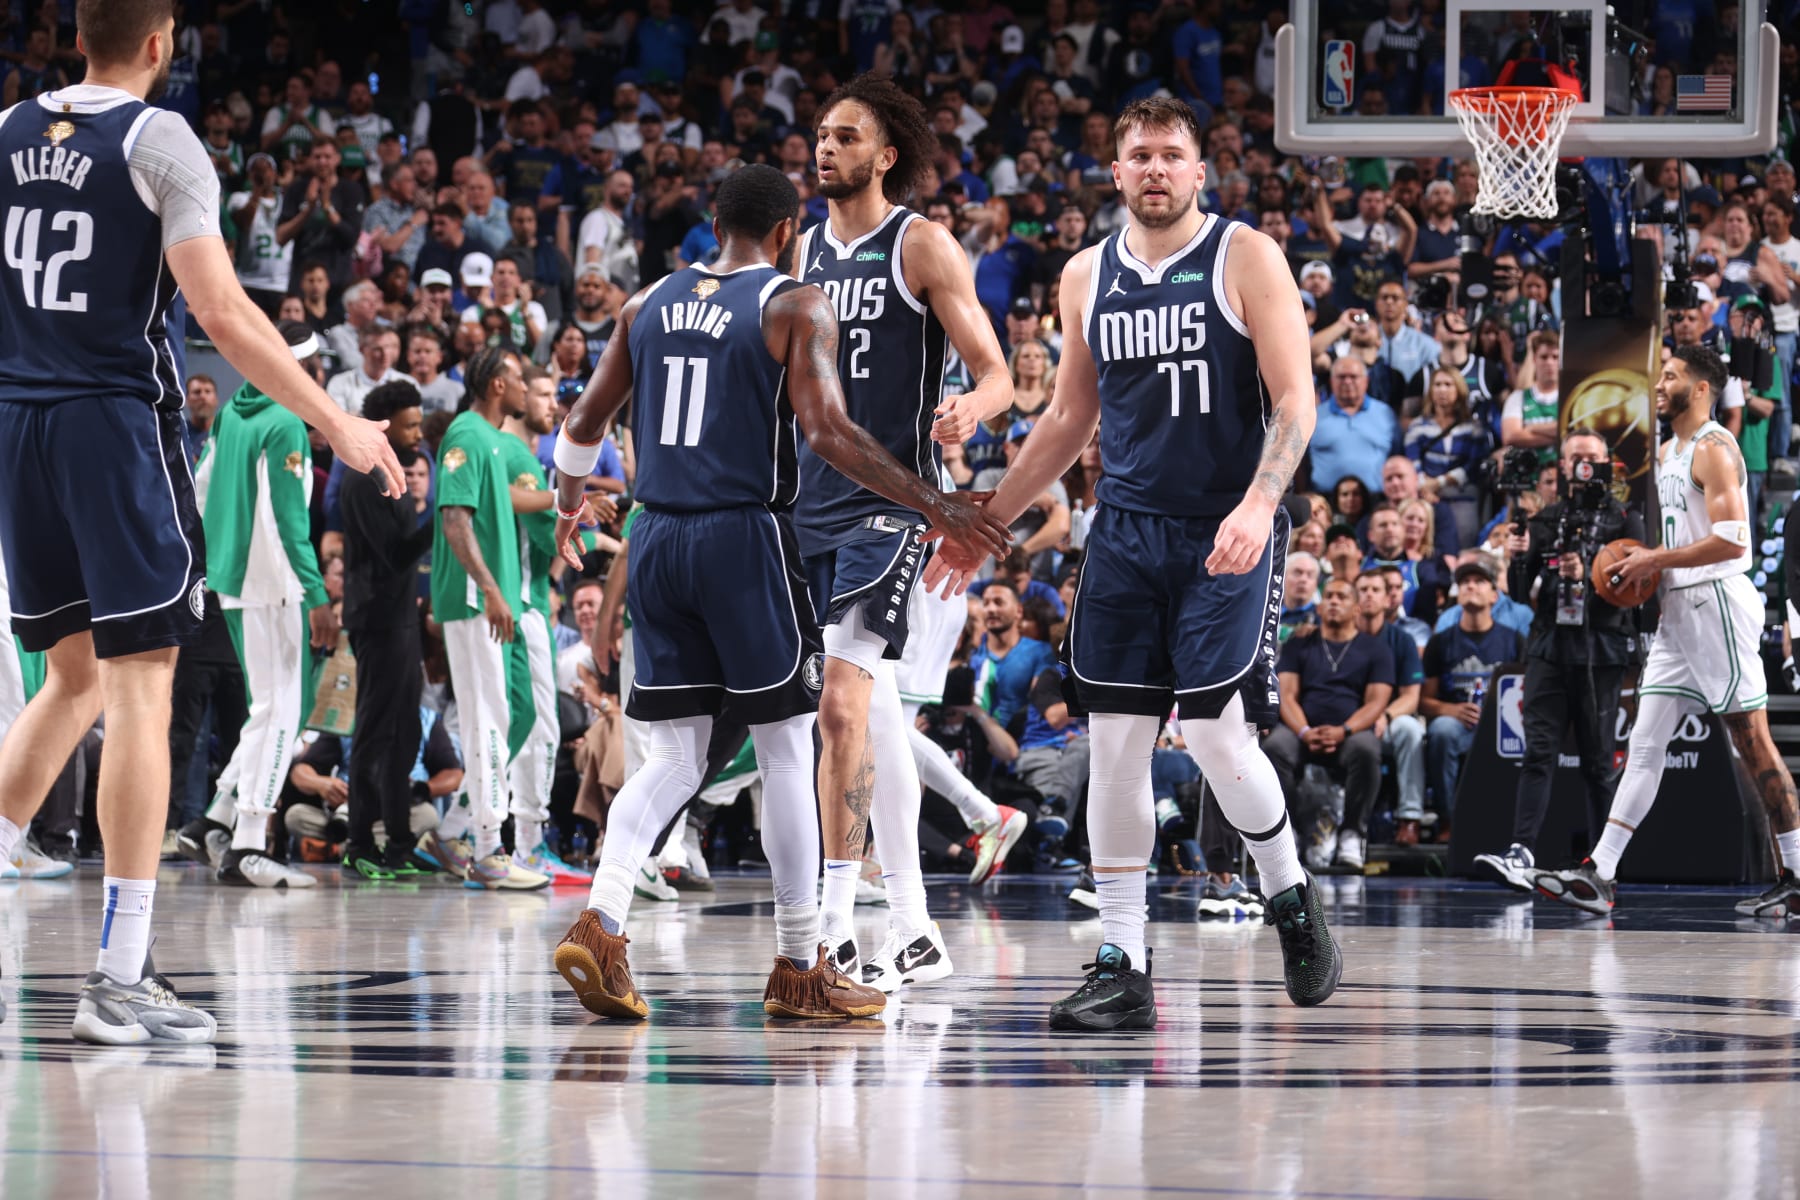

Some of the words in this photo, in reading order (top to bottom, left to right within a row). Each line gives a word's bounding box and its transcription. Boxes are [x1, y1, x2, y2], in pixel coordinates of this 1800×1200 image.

[10, 146, 93, 191] KLEBER
[4, 205, 94, 312] 42
[856, 251, 886, 262] chime
[1171, 271, 1204, 284] chime
[661, 301, 733, 339] IRVING
[813, 277, 888, 322] AVS
[849, 327, 871, 379] 2
[659, 355, 709, 447] 11
[1157, 359, 1210, 417] 77
[274, 729, 286, 769] BOSTON
[1502, 738, 1521, 753] NBA
